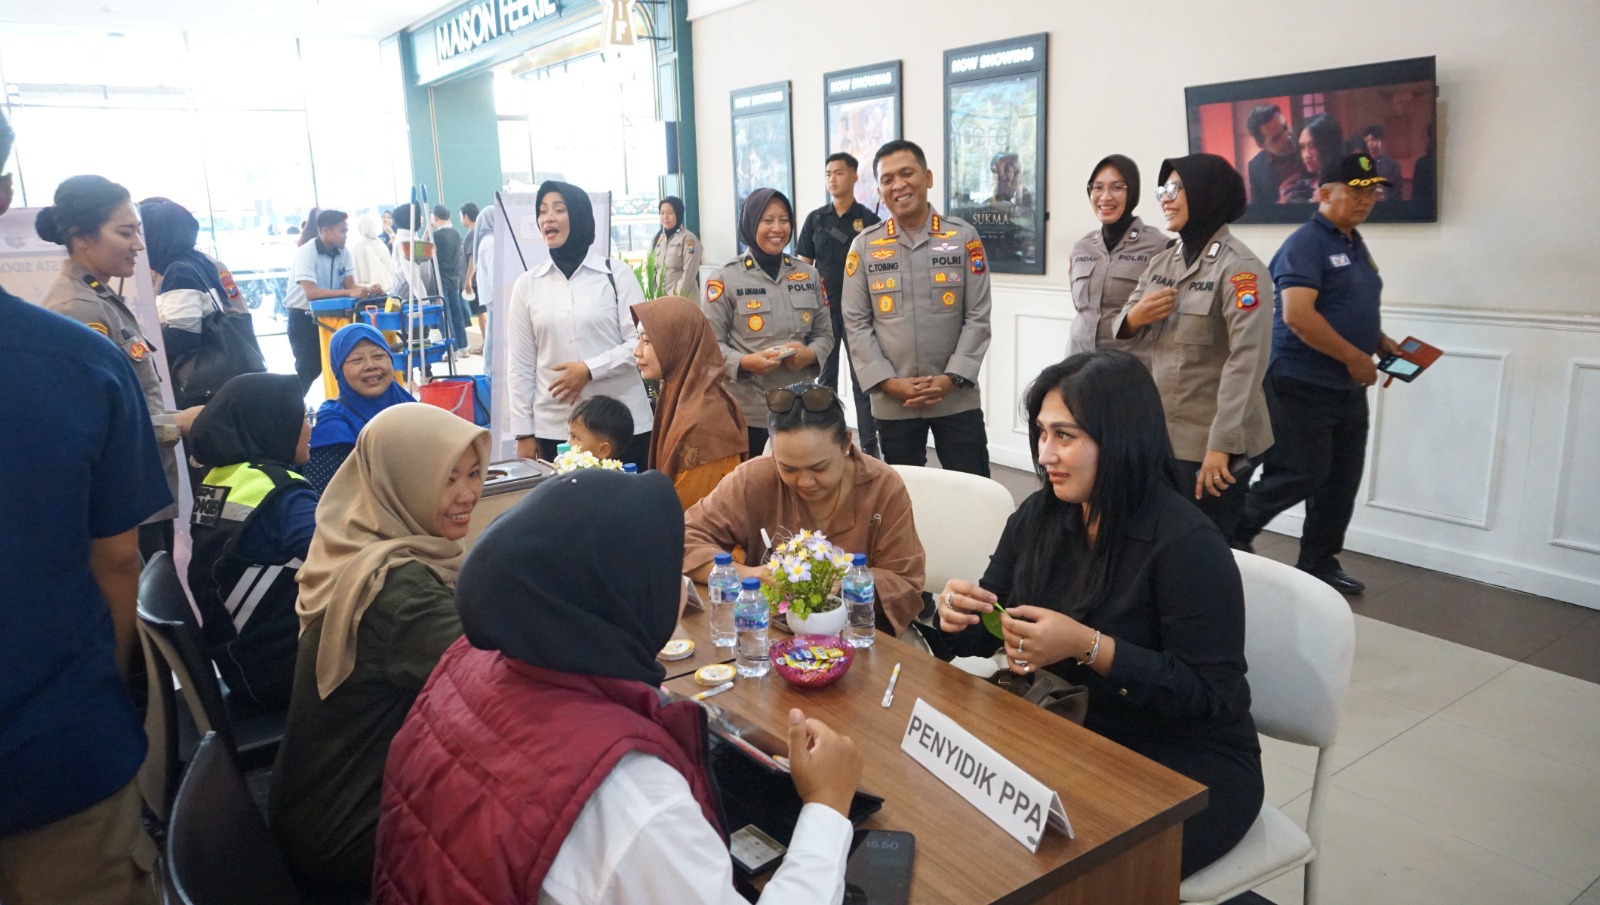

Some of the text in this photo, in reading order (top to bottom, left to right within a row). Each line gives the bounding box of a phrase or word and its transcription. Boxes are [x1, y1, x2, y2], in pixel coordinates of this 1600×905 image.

[436, 0, 497, 59] MAISON
[952, 46, 1034, 73] NOW SHOWING
[972, 213, 1009, 225] SUKMA
[932, 256, 961, 266] POLRI
[1119, 254, 1148, 263] POLRI
[868, 262, 899, 274] C.TOBING
[1151, 274, 1176, 288] FIAN
[1189, 281, 1214, 292] POLRI
[788, 283, 815, 292] POLRI
[908, 715, 1042, 833] PENYIDIK PPA
